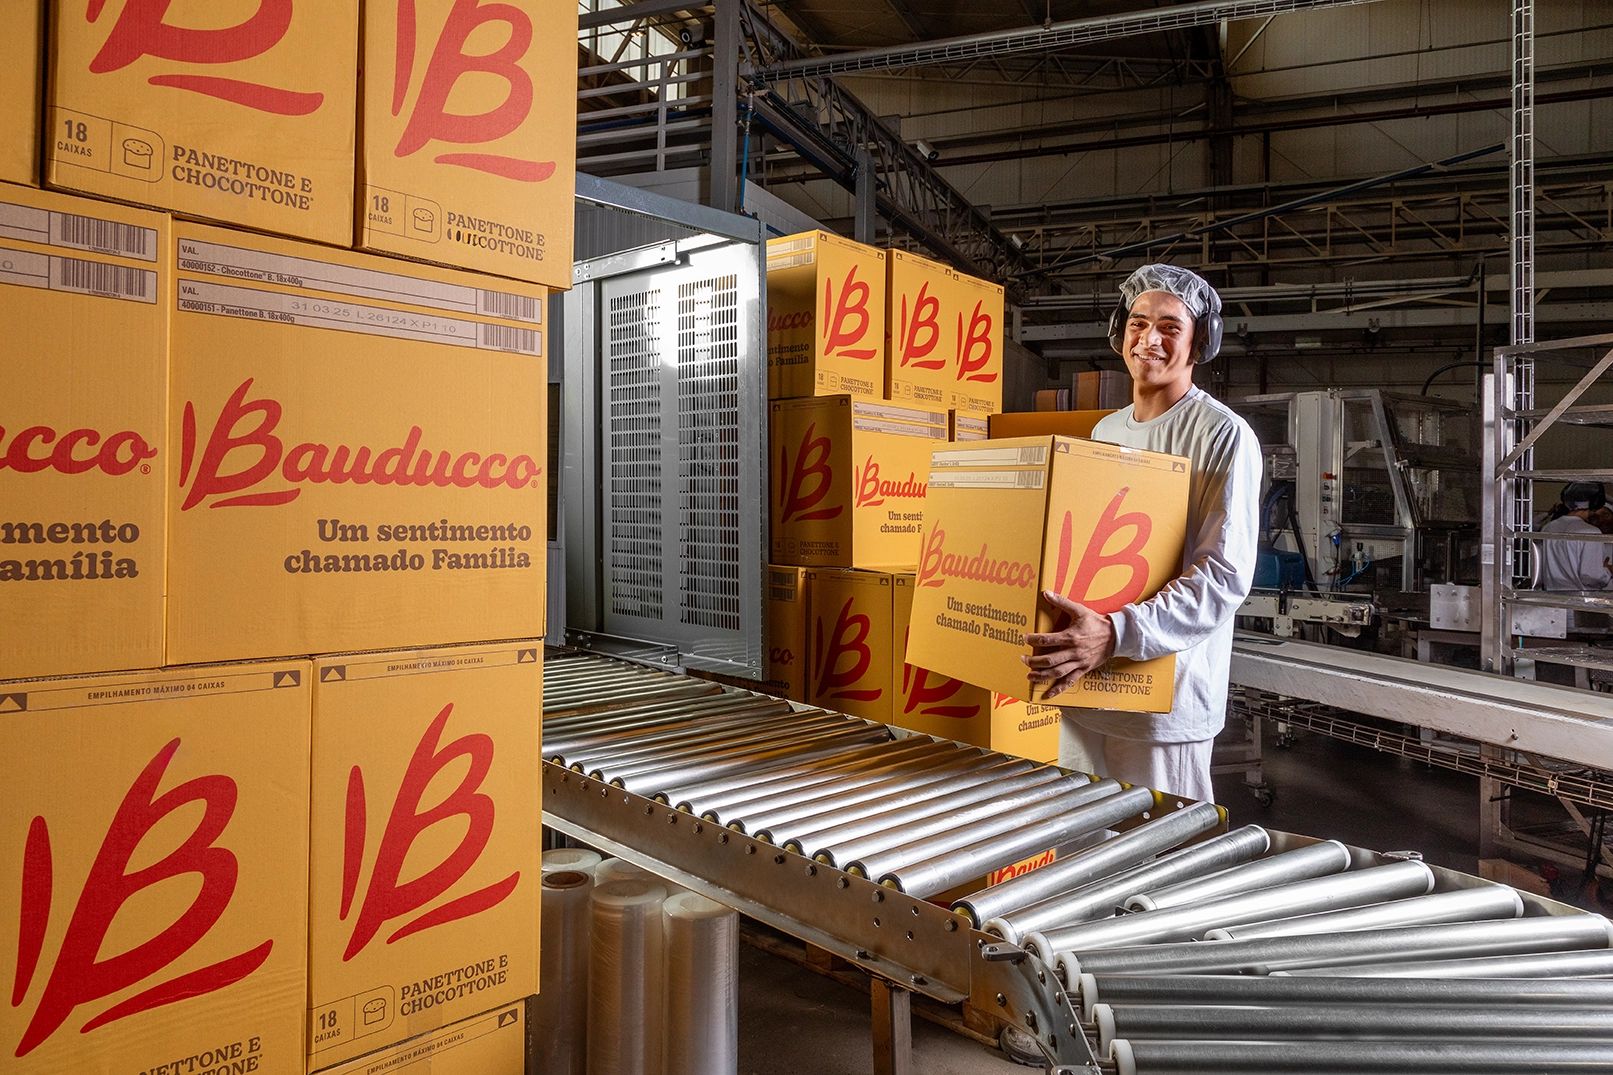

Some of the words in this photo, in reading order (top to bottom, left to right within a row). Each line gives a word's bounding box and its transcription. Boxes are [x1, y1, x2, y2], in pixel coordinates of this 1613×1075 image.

[64, 120, 88, 143] 18
[57, 141, 92, 158] CAIXAS
[172, 144, 296, 189] PANETTONE
[300, 178, 313, 194] E
[172, 165, 311, 211] CHOCOTTONE
[372, 194, 390, 213] 18
[368, 212, 393, 225] CAIXAS
[447, 212, 534, 244] PANETTONE
[536, 234, 546, 247] E
[182, 245, 200, 256] VAL.
[267, 273, 275, 282] B.
[276, 274, 304, 287] 18x400g
[181, 300, 216, 313] 40000151
[220, 306, 258, 318] Panettone
[259, 310, 266, 319] B.
[267, 312, 296, 324] 18x400g
[182, 286, 200, 296] VAL.
[291, 302, 308, 311] 31
[312, 304, 330, 314] 03
[334, 306, 350, 318] 25
[368, 312, 406, 326] 26124
[422, 322, 438, 330] P1
[442, 325, 457, 334] 10
[178, 376, 543, 512] Bauducco
[888, 510, 902, 521] Um
[902, 511, 924, 521] senti
[317, 518, 370, 542] Um
[376, 518, 532, 542] sentimento
[880, 524, 916, 533] chamado
[284, 549, 426, 574] chamado
[431, 546, 532, 570] Família
[916, 520, 1036, 588] Bauducco
[947, 596, 964, 612] Um
[964, 603, 1027, 627] sentimento
[936, 612, 981, 636] chamado
[982, 622, 1025, 647] Família
[1083, 680, 1152, 696] CHOCOTTONE
[1084, 670, 1144, 684] PANETTONE
[1146, 674, 1153, 684] E
[88, 687, 152, 700] EMPILHAMENTO
[153, 684, 185, 694] MÁXIMO
[198, 681, 226, 690] CAIXAS
[1018, 716, 1054, 732] chamado
[400, 958, 495, 1000] PANETTONE
[498, 954, 508, 969] E
[400, 970, 508, 1017] CHOCOTTONE
[318, 1010, 338, 1030] 18
[248, 1036, 260, 1054] E
[314, 1028, 341, 1044] CAIXAS
[367, 1053, 412, 1075] EMPILHAMENTO
[412, 1044, 436, 1058] MÁXIMO
[444, 1032, 464, 1046] CAIXAS
